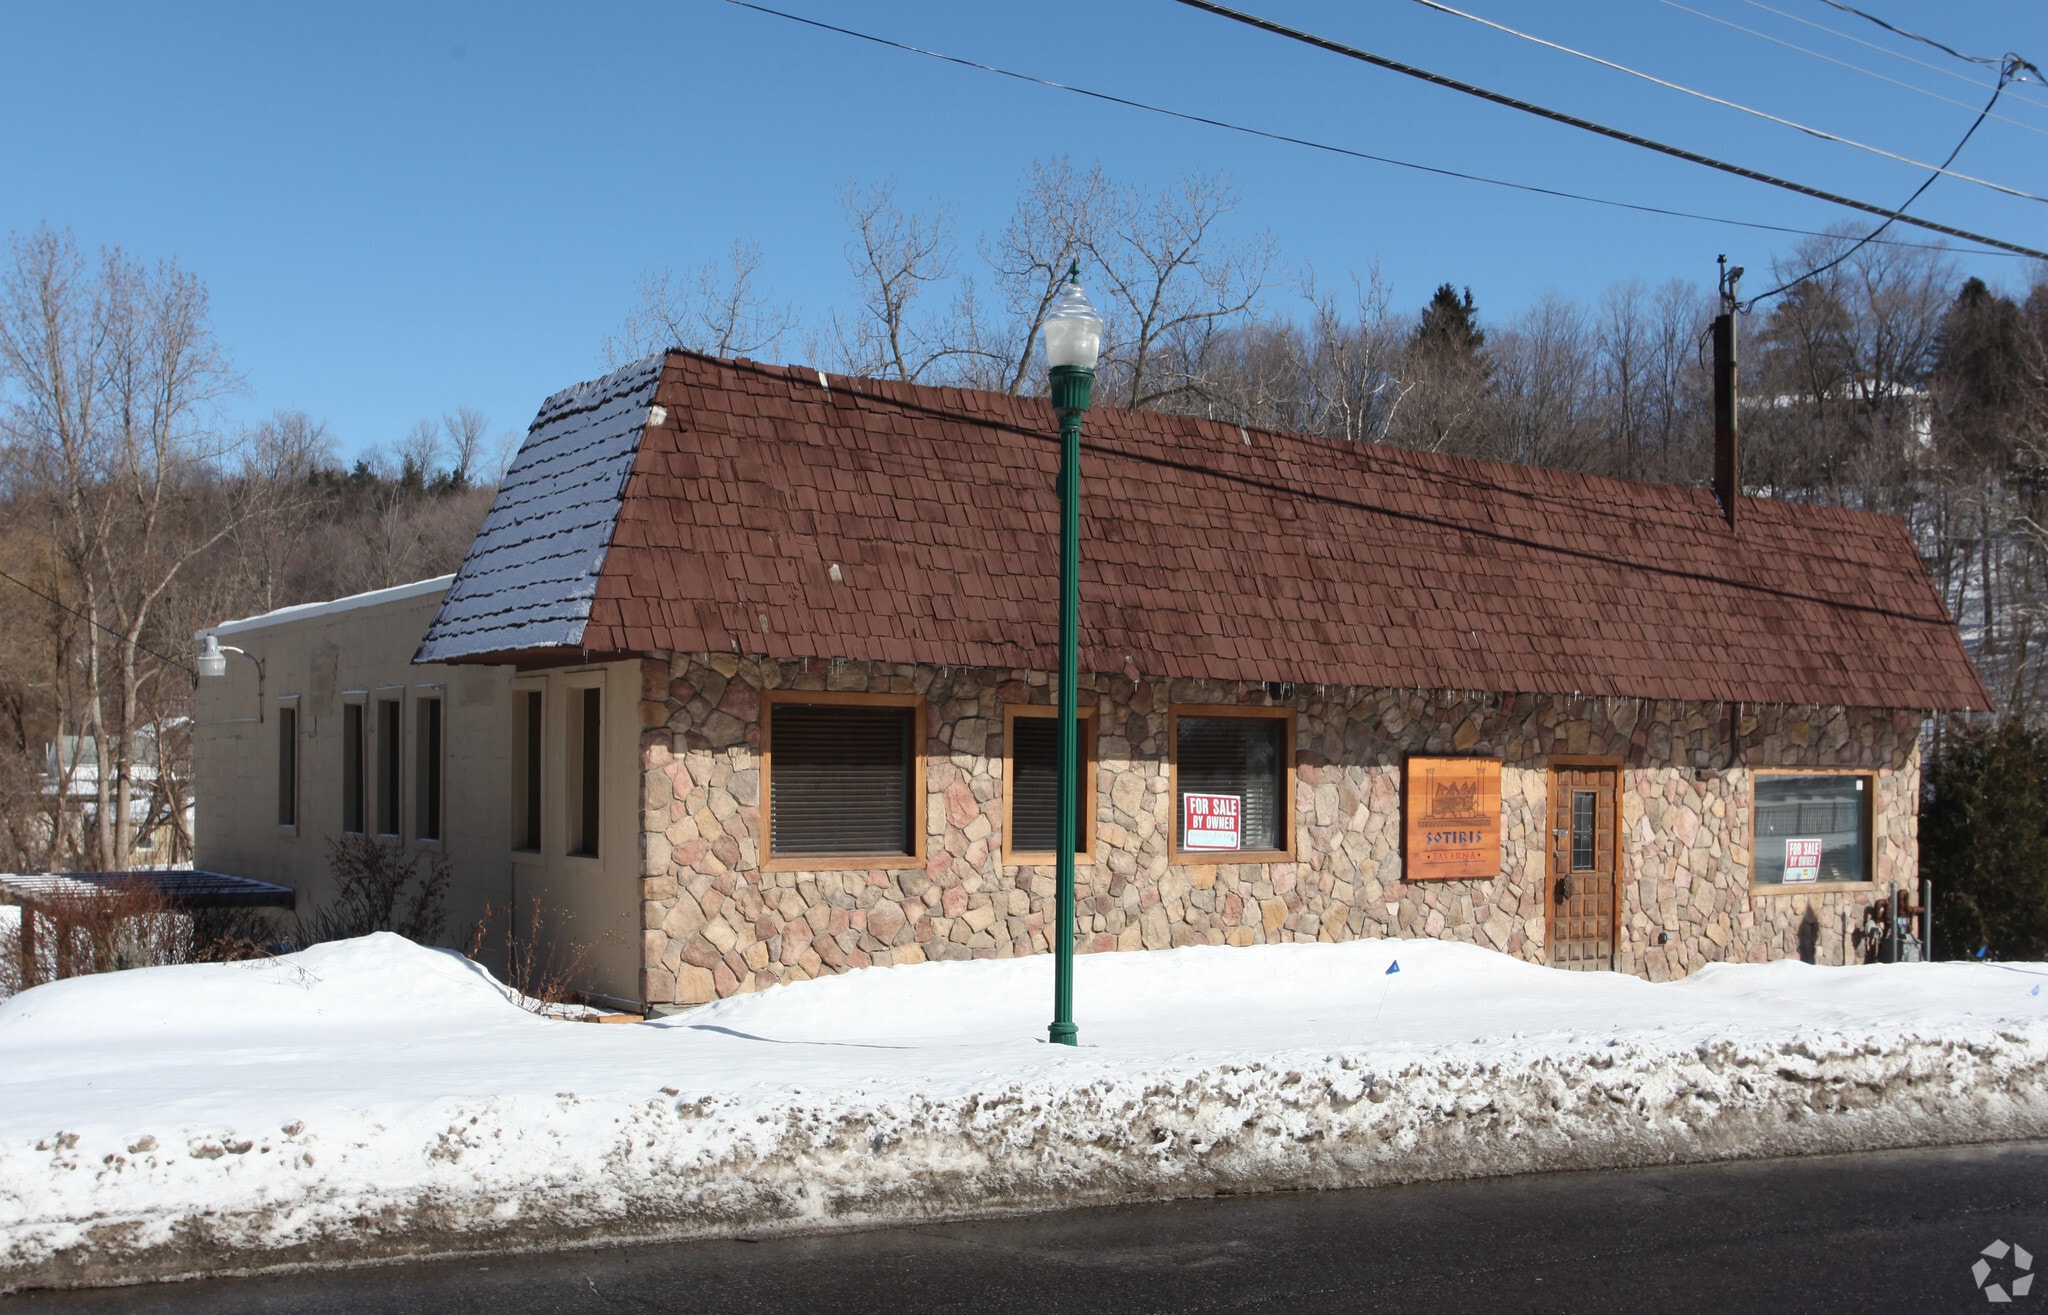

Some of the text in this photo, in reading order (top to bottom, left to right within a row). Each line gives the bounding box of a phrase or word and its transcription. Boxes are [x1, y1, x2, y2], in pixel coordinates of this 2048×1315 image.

[1190, 798, 1237, 815] FOR SALE
[1193, 815, 1235, 830] BY OWNER
[1426, 831, 1482, 845] SOTIRIS
[1790, 842, 1819, 855] FOR SALE
[1433, 852, 1476, 861] TAVERNA
[1790, 856, 1797, 867] BY
